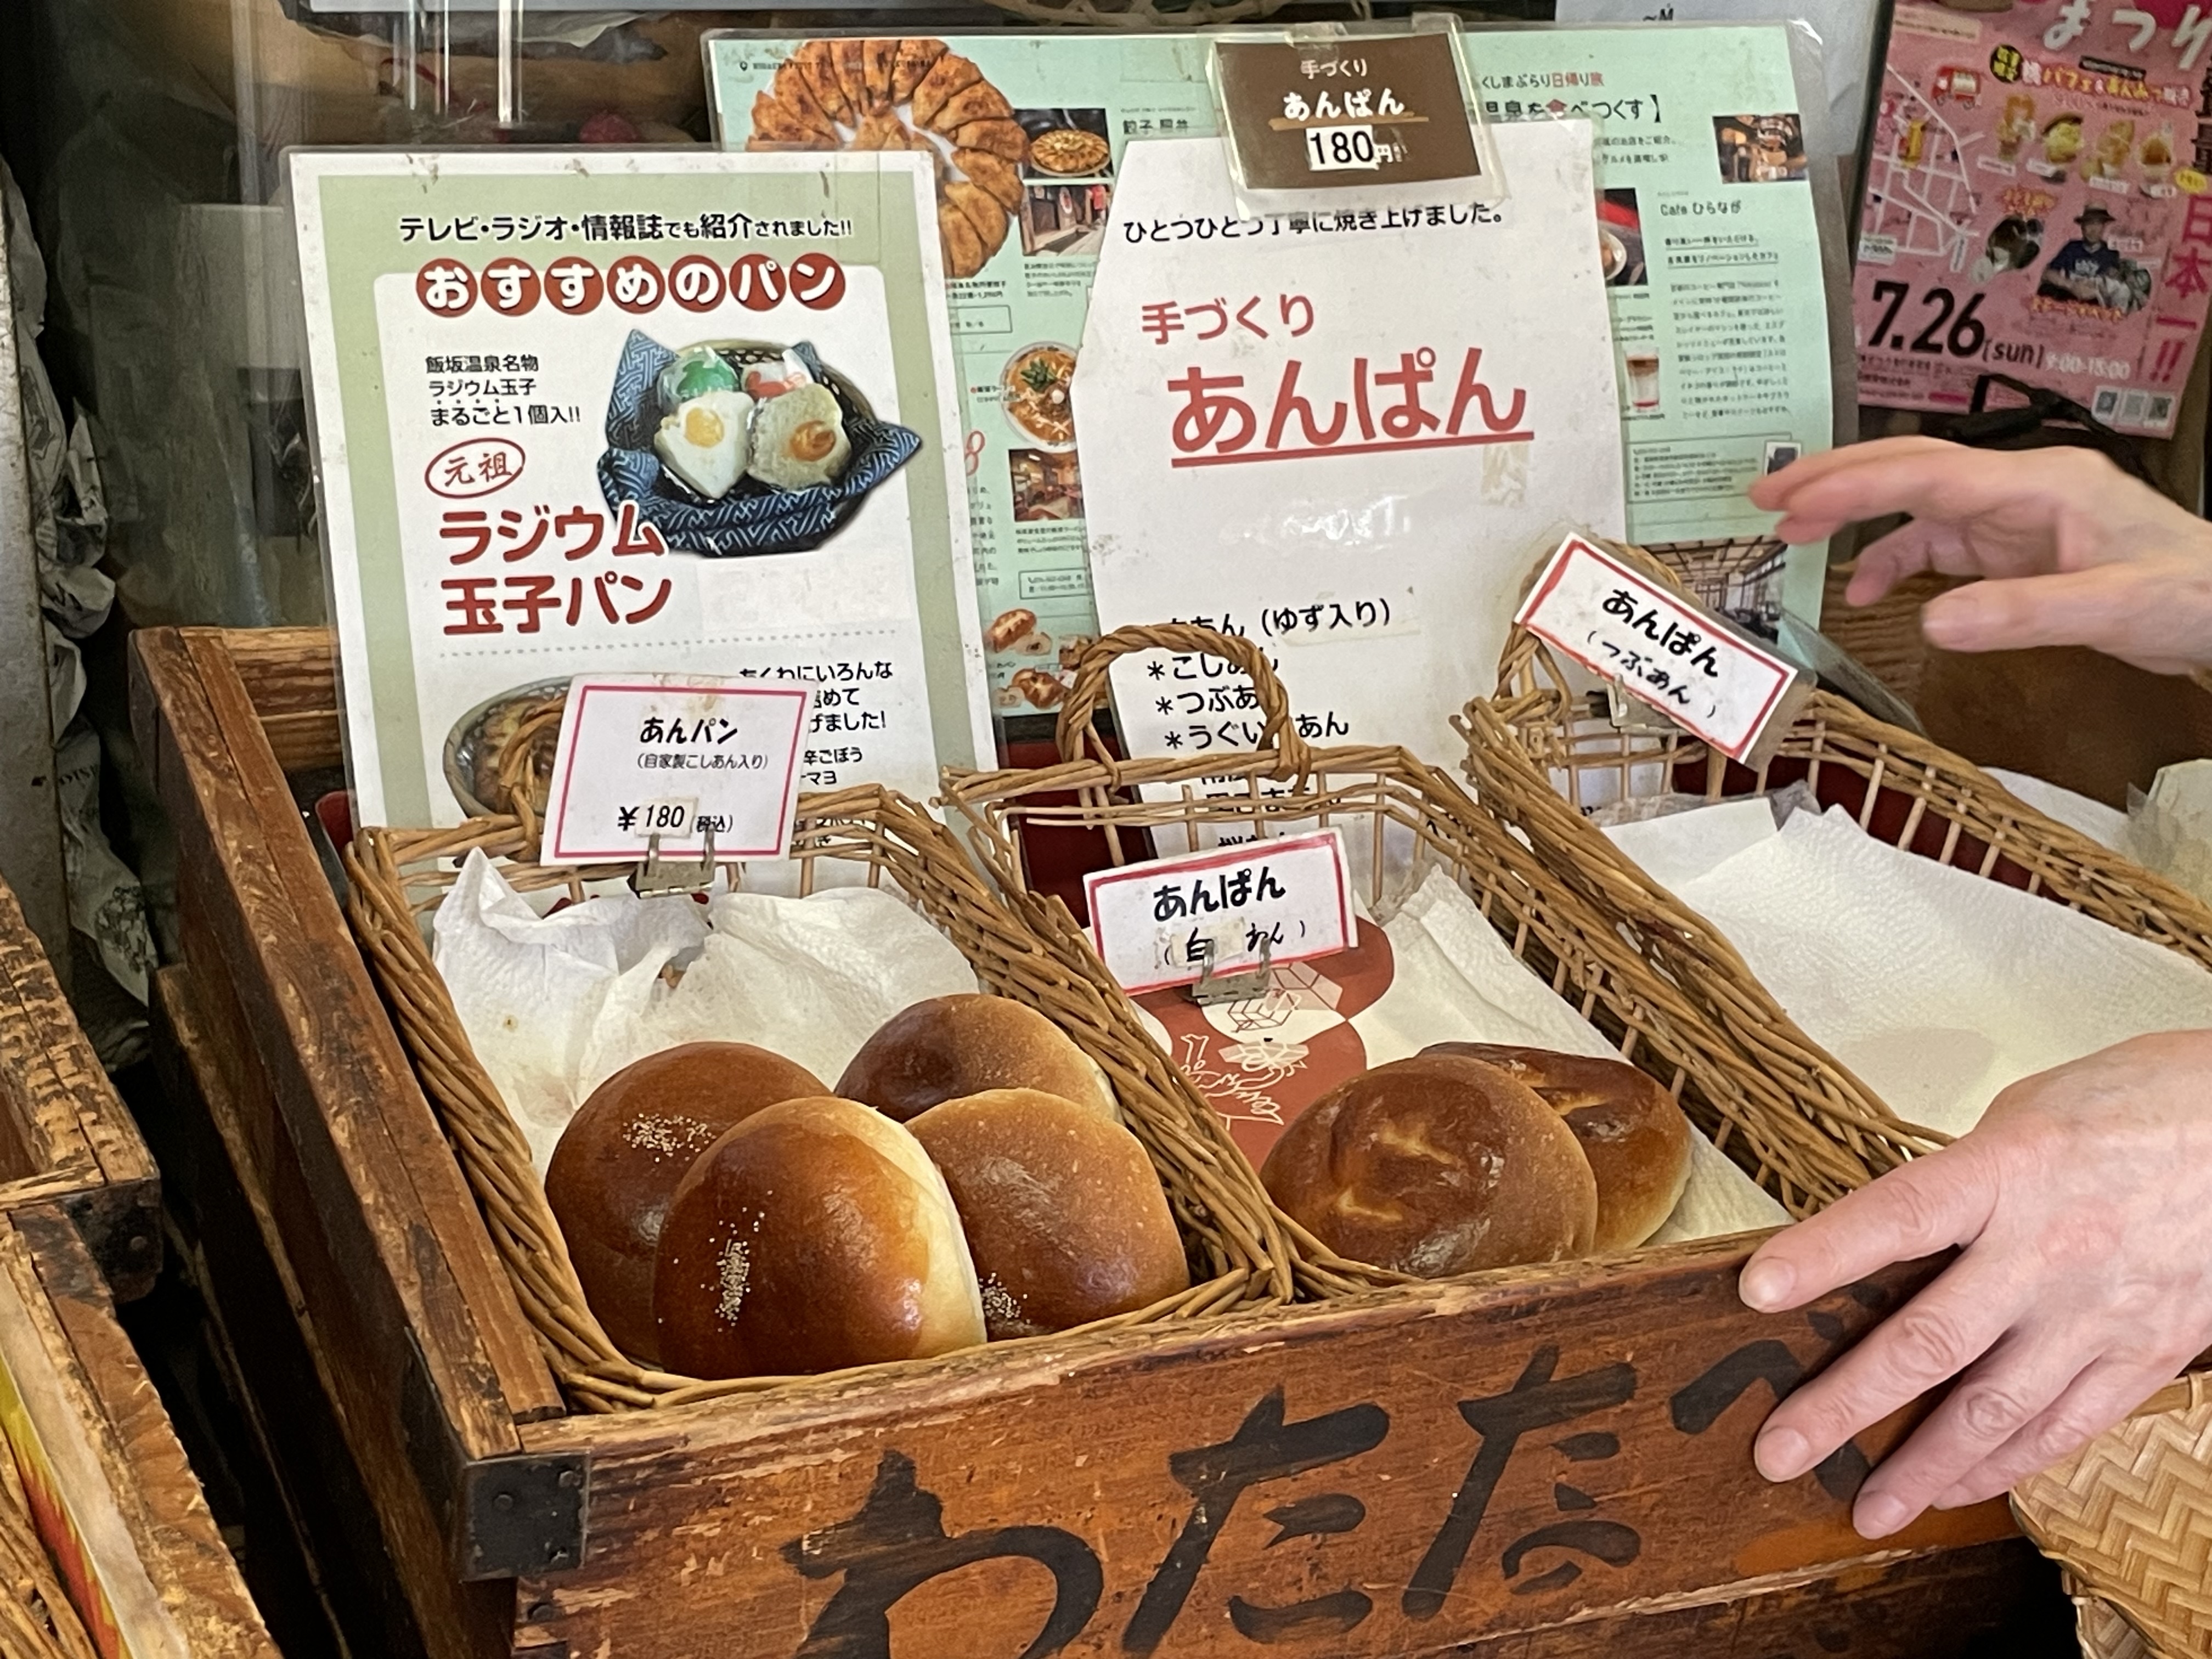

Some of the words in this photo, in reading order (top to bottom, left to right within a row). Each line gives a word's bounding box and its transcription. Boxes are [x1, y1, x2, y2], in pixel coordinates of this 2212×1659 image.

[1300, 59, 1368, 79] 手づくり
[1283, 88, 1406, 121] あんぱん
[1124, 202, 1503, 243] ひとつひとつ丁寧に焼き上げました。
[424, 260, 837, 309] おすすめのパン
[1141, 293, 1314, 345] 手づくり
[1867, 279, 1986, 358] 7.26
[426, 356, 539, 374] 飯坂温泉名物
[429, 379, 537, 397] ラジウム玉子
[1167, 347, 1527, 454] あんぱん
[444, 451, 513, 487] 元祖
[439, 504, 665, 566] ラジウム
[441, 571, 672, 635] 玉子パン
[1262, 598, 1390, 636] (ゆず入り)
[1602, 589, 1718, 678] あんぱん
[1587, 630, 1716, 718] (つぶあん)
[639, 717, 738, 744] あんパン
[637, 753, 768, 770] (自家製こしあん入り)
[1153, 866, 1286, 922] あんぱん
